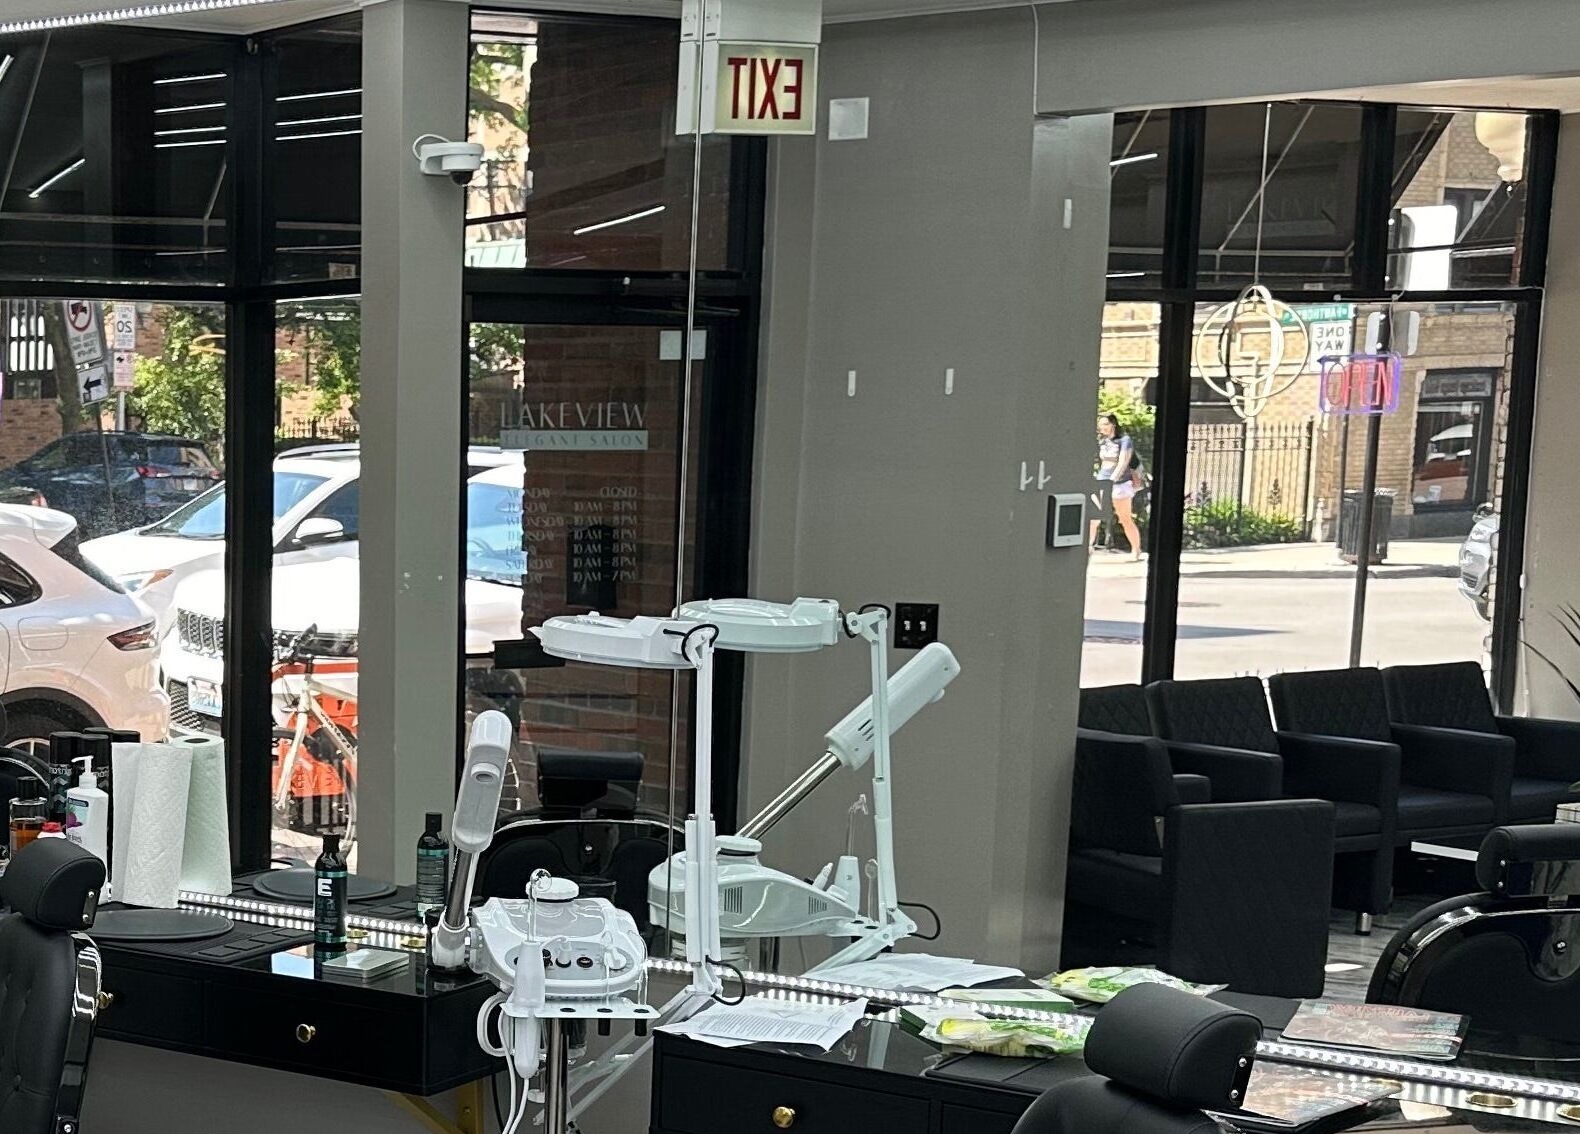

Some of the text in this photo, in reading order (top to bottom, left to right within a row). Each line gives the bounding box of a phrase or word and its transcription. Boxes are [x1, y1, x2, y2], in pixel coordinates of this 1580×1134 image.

[1327, 361, 1393, 406] OPEN
[500, 402, 646, 428] LAKEVIEW
[590, 433, 645, 446] SALON
